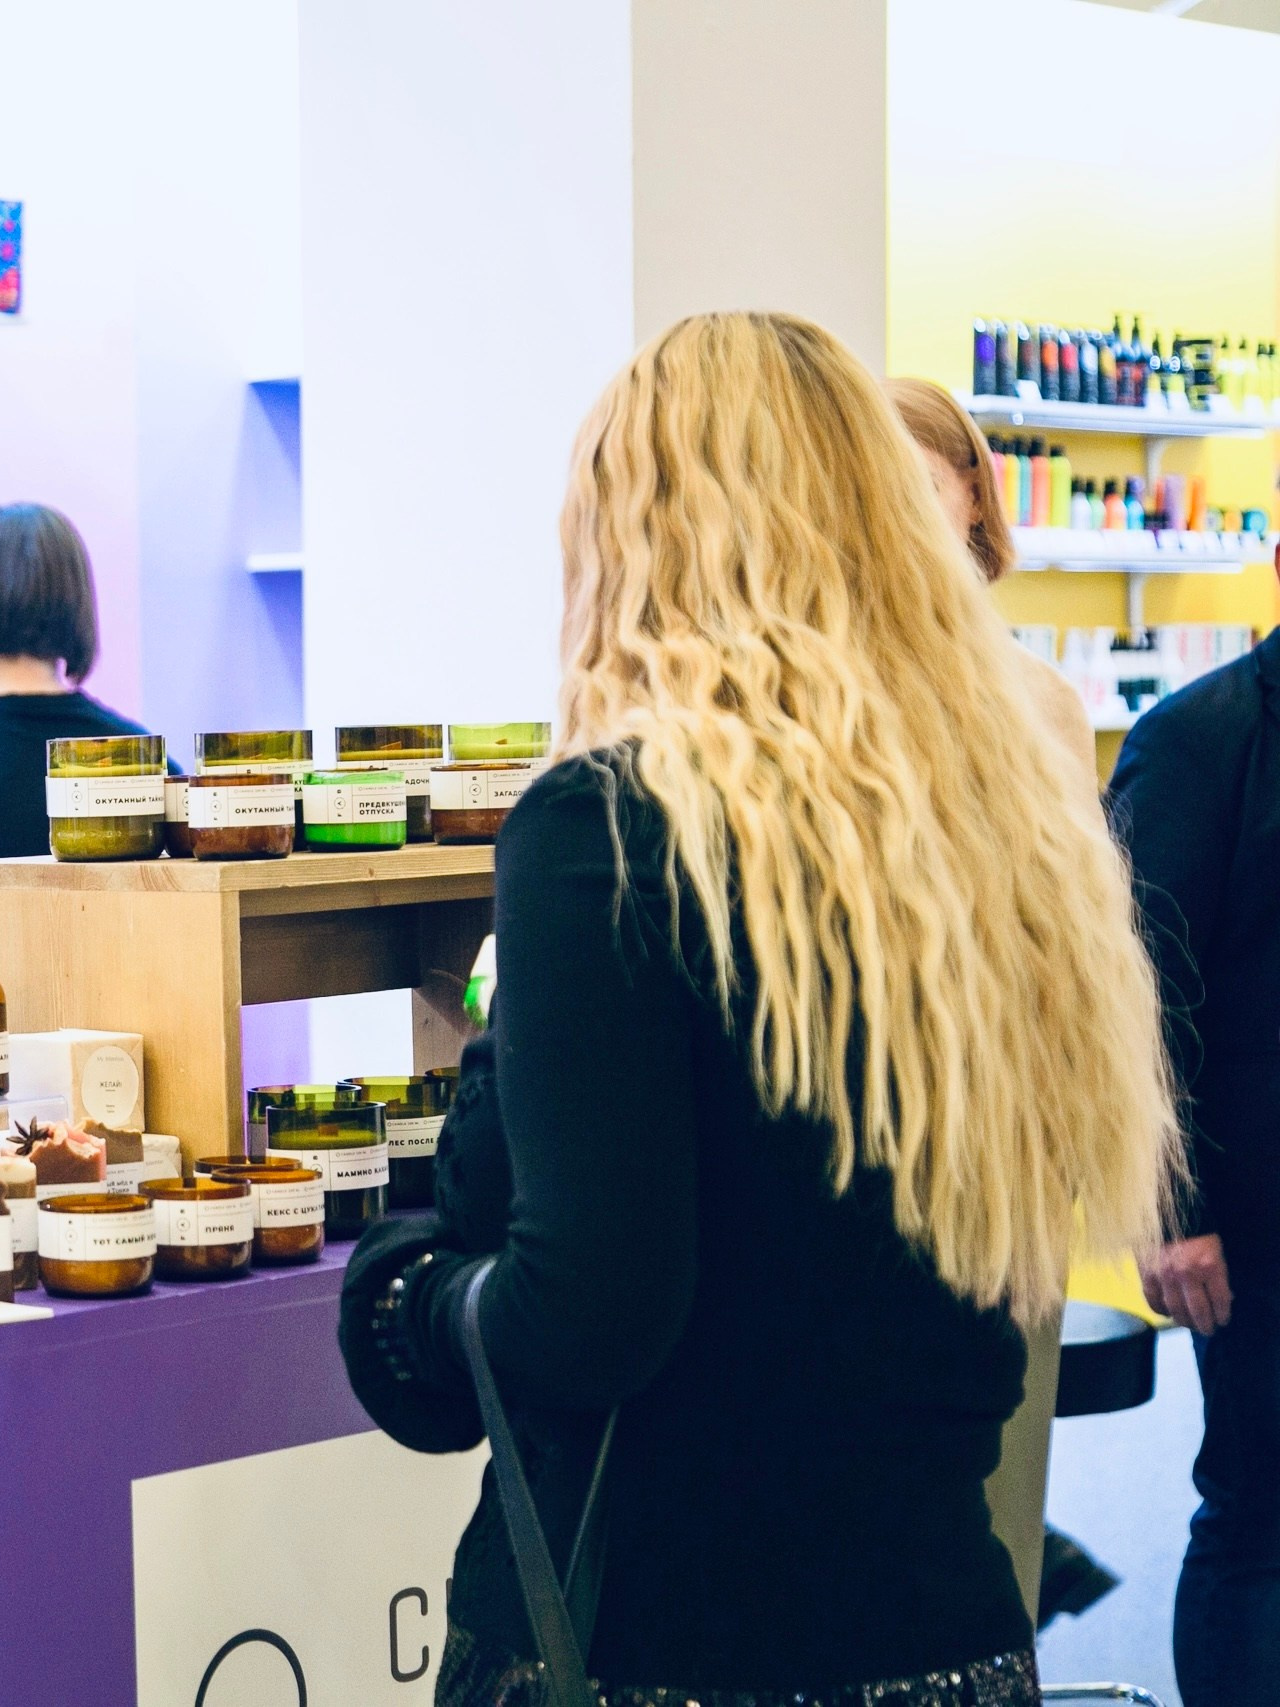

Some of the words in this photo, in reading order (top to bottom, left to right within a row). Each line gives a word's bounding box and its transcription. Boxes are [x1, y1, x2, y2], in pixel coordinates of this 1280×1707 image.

[494, 790, 523, 798] ЗАГАДО
[95, 796, 147, 805] ОКУТАННЫЙ
[235, 805, 284, 814] ОКУТАННЫЙ
[388, 1139, 405, 1147] ЛЕС
[408, 1137, 434, 1146] ПОСЛЕ
[337, 1168, 372, 1178] МАМИНО
[267, 1208, 291, 1217] КЕКС
[116, 1234, 145, 1245] САМЫЙ
